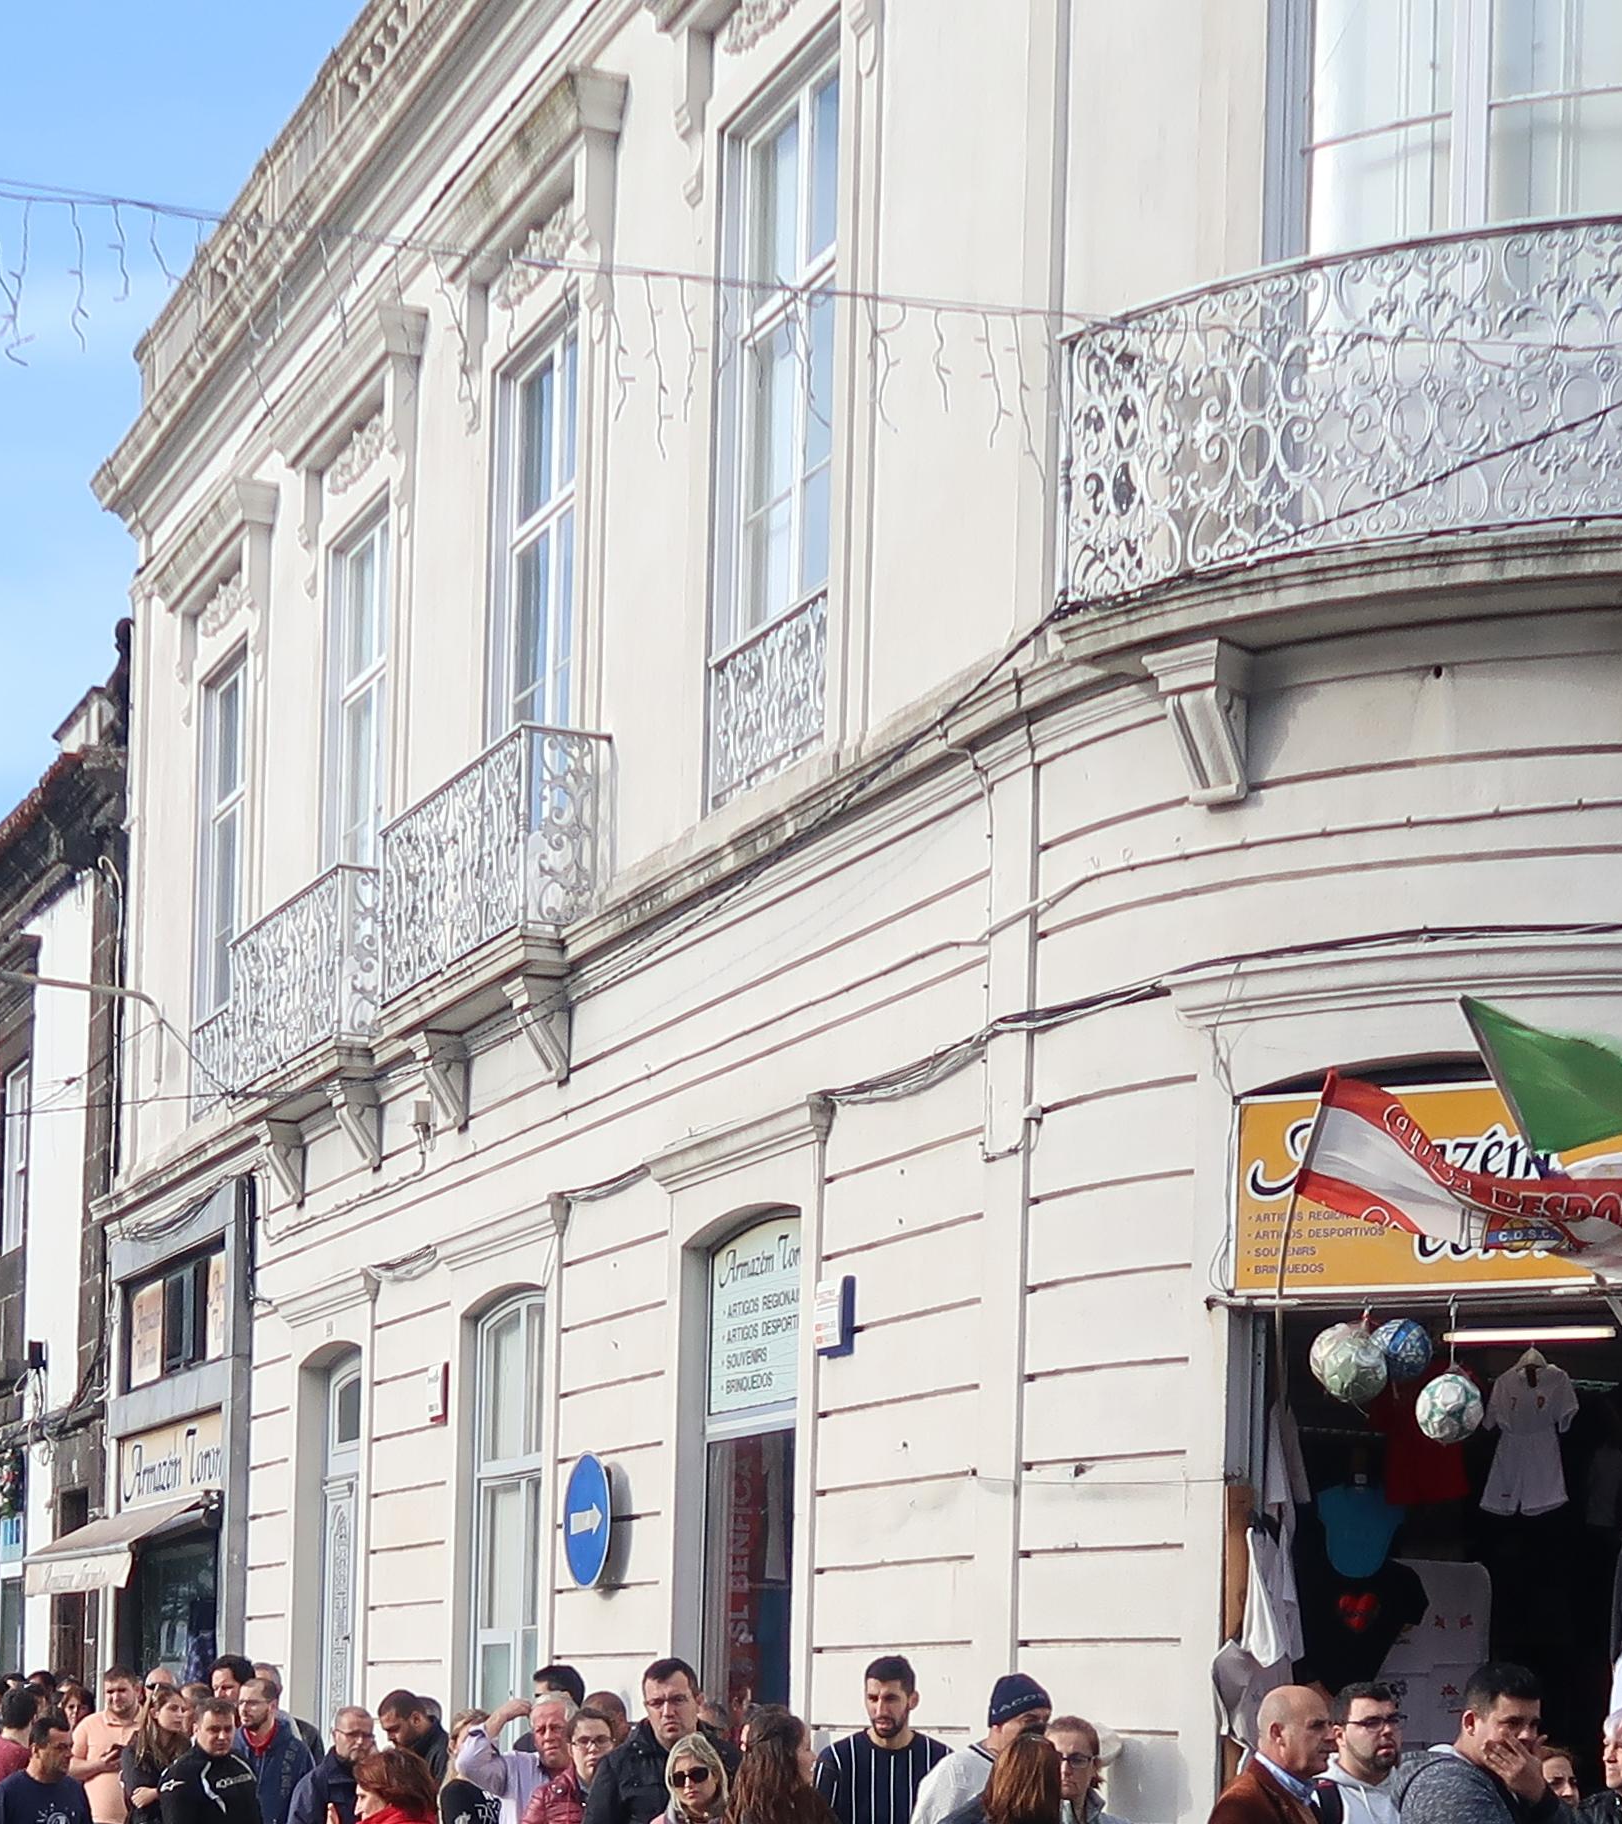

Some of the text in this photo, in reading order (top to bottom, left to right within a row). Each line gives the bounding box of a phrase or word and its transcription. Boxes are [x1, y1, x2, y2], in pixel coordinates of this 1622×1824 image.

[1307, 1226, 1386, 1238] DESPORTIVOS
[1253, 1246, 1317, 1258] SOUENIRS
[719, 1248, 775, 1289] Armazém
[1253, 1263, 1325, 1275] BRINUEDOS
[727, 1297, 759, 1319] ARTIGOS
[726, 1323, 759, 1345] ARTIGOS
[726, 1346, 768, 1370] SOUVENIRS
[725, 1371, 774, 1395] BRINQUEDOS
[123, 1443, 182, 1504] Armazém
